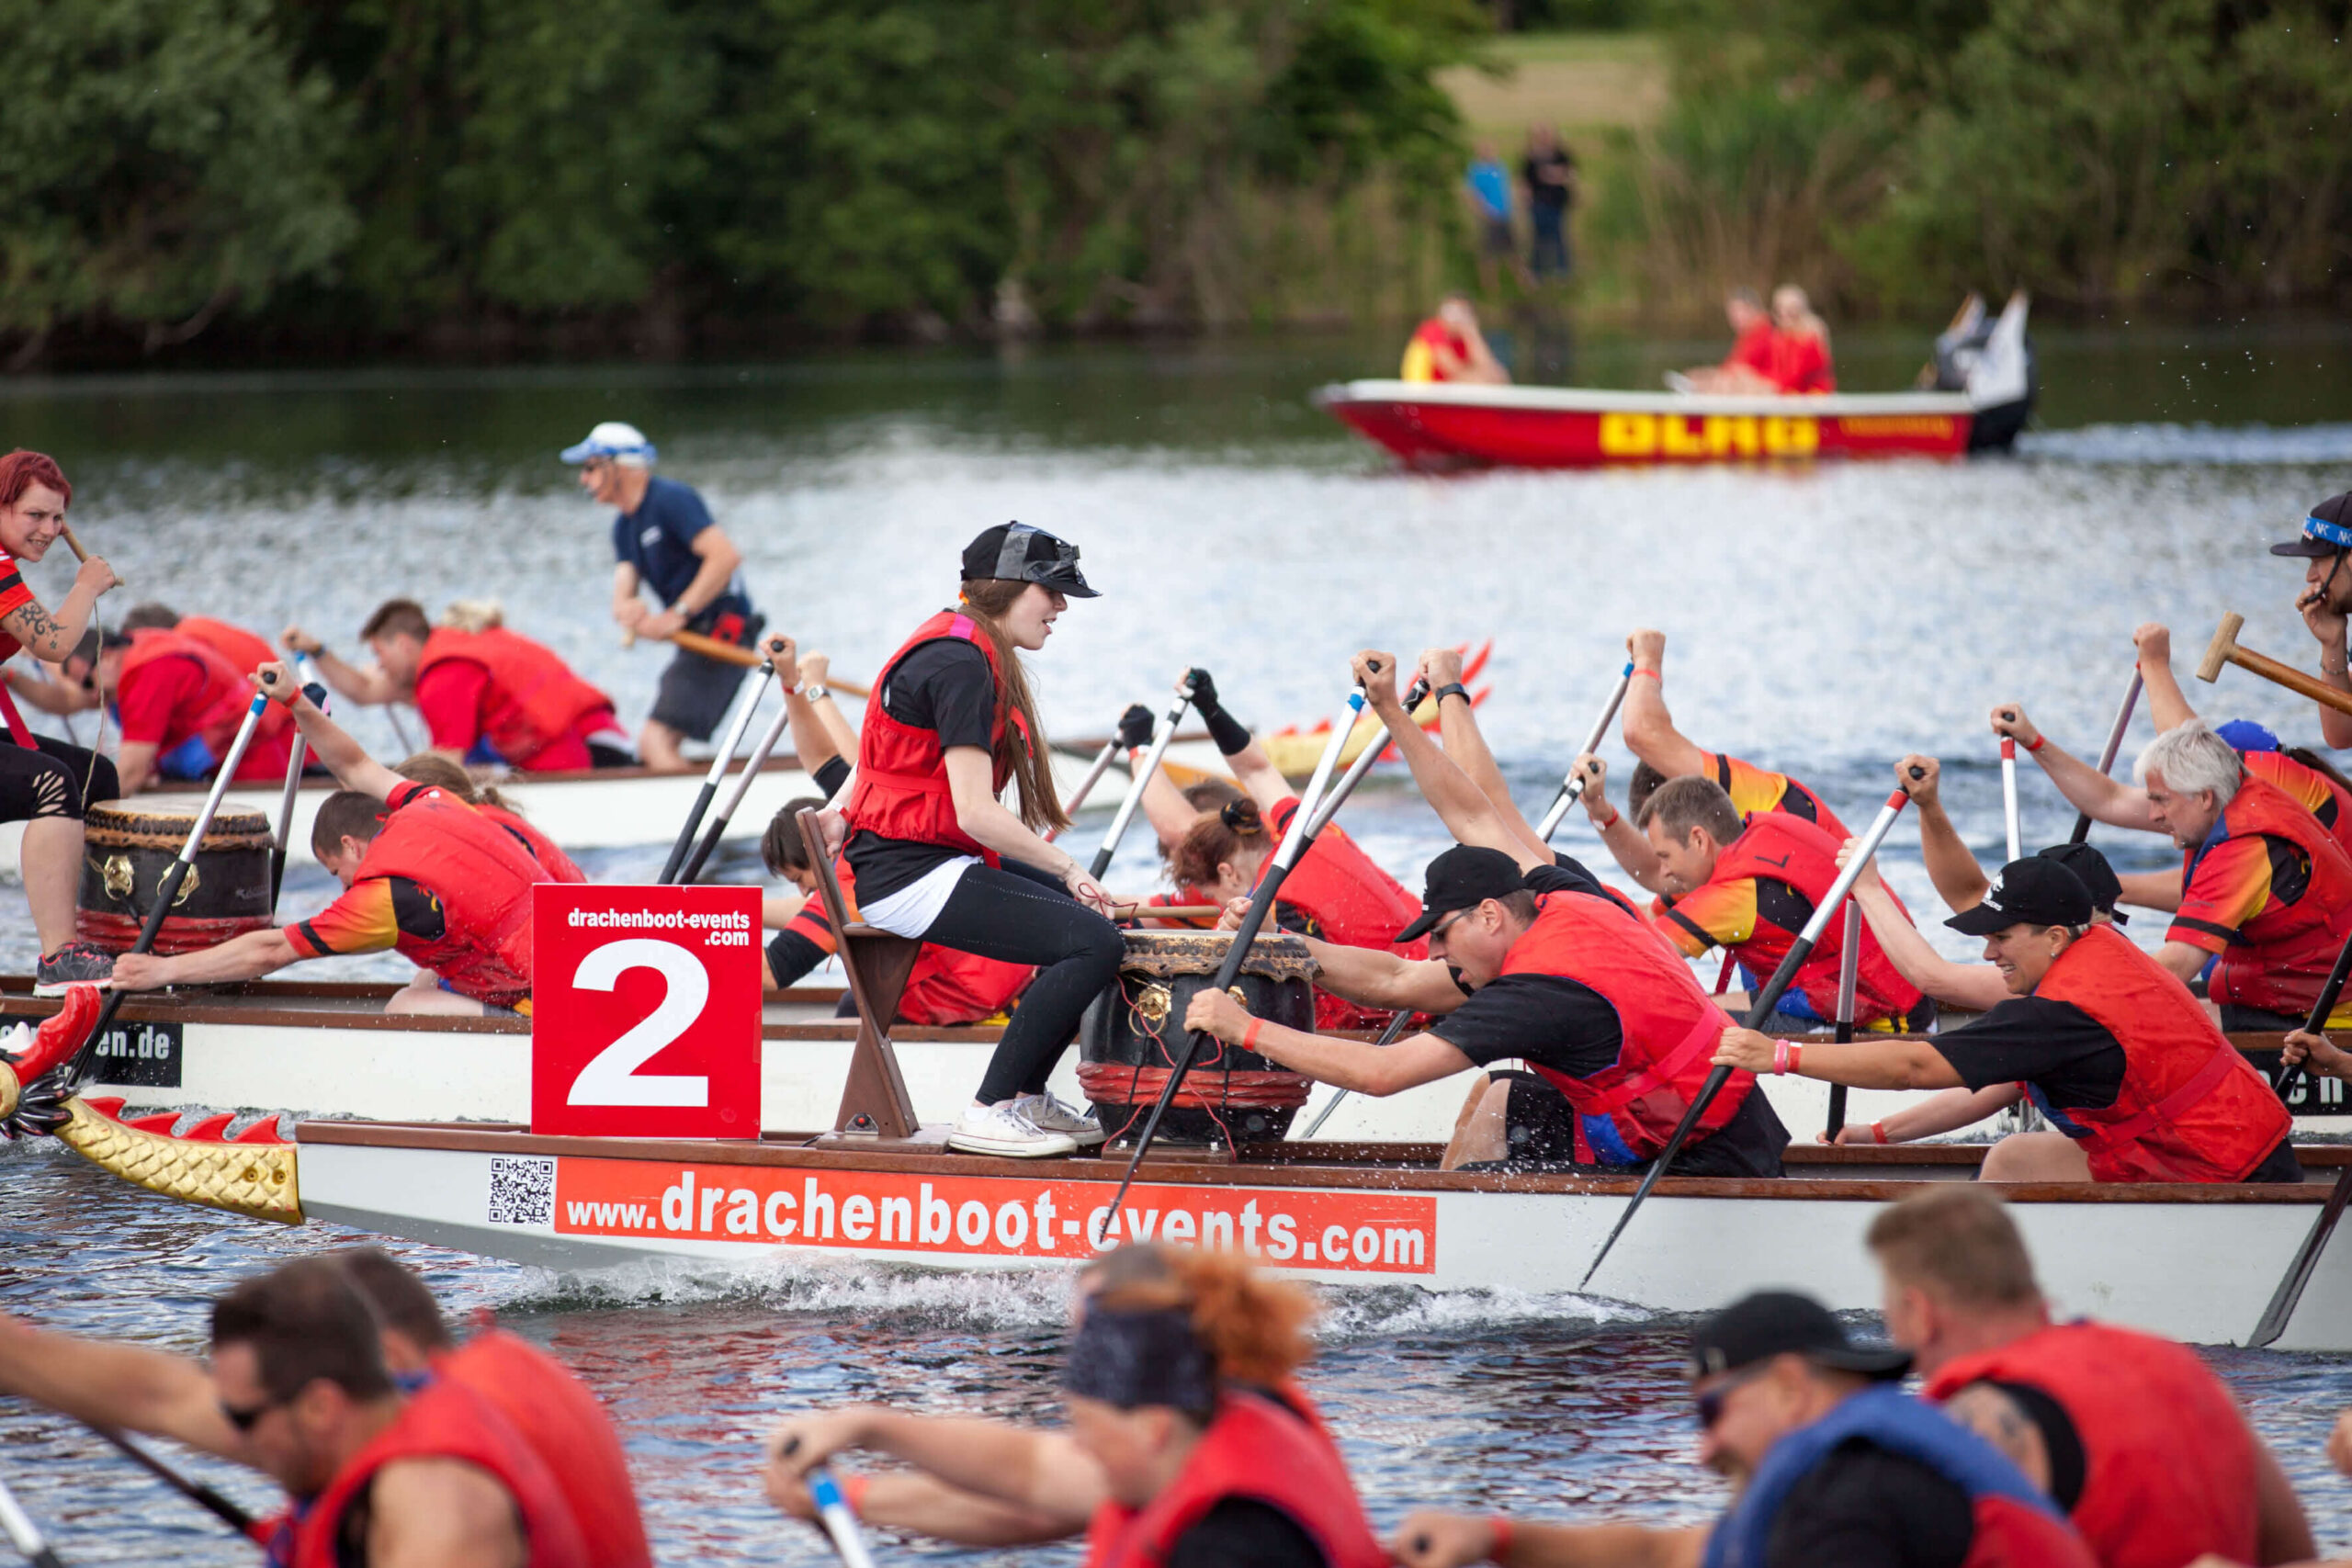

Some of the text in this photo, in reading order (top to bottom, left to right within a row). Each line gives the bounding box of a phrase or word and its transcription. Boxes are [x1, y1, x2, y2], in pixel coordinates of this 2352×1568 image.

[568, 908, 751, 929] drachenboot-events
[705, 931, 750, 946] .com
[567, 938, 709, 1107] 2
[566, 1171, 1425, 1266] www.drachenboot-events.com
